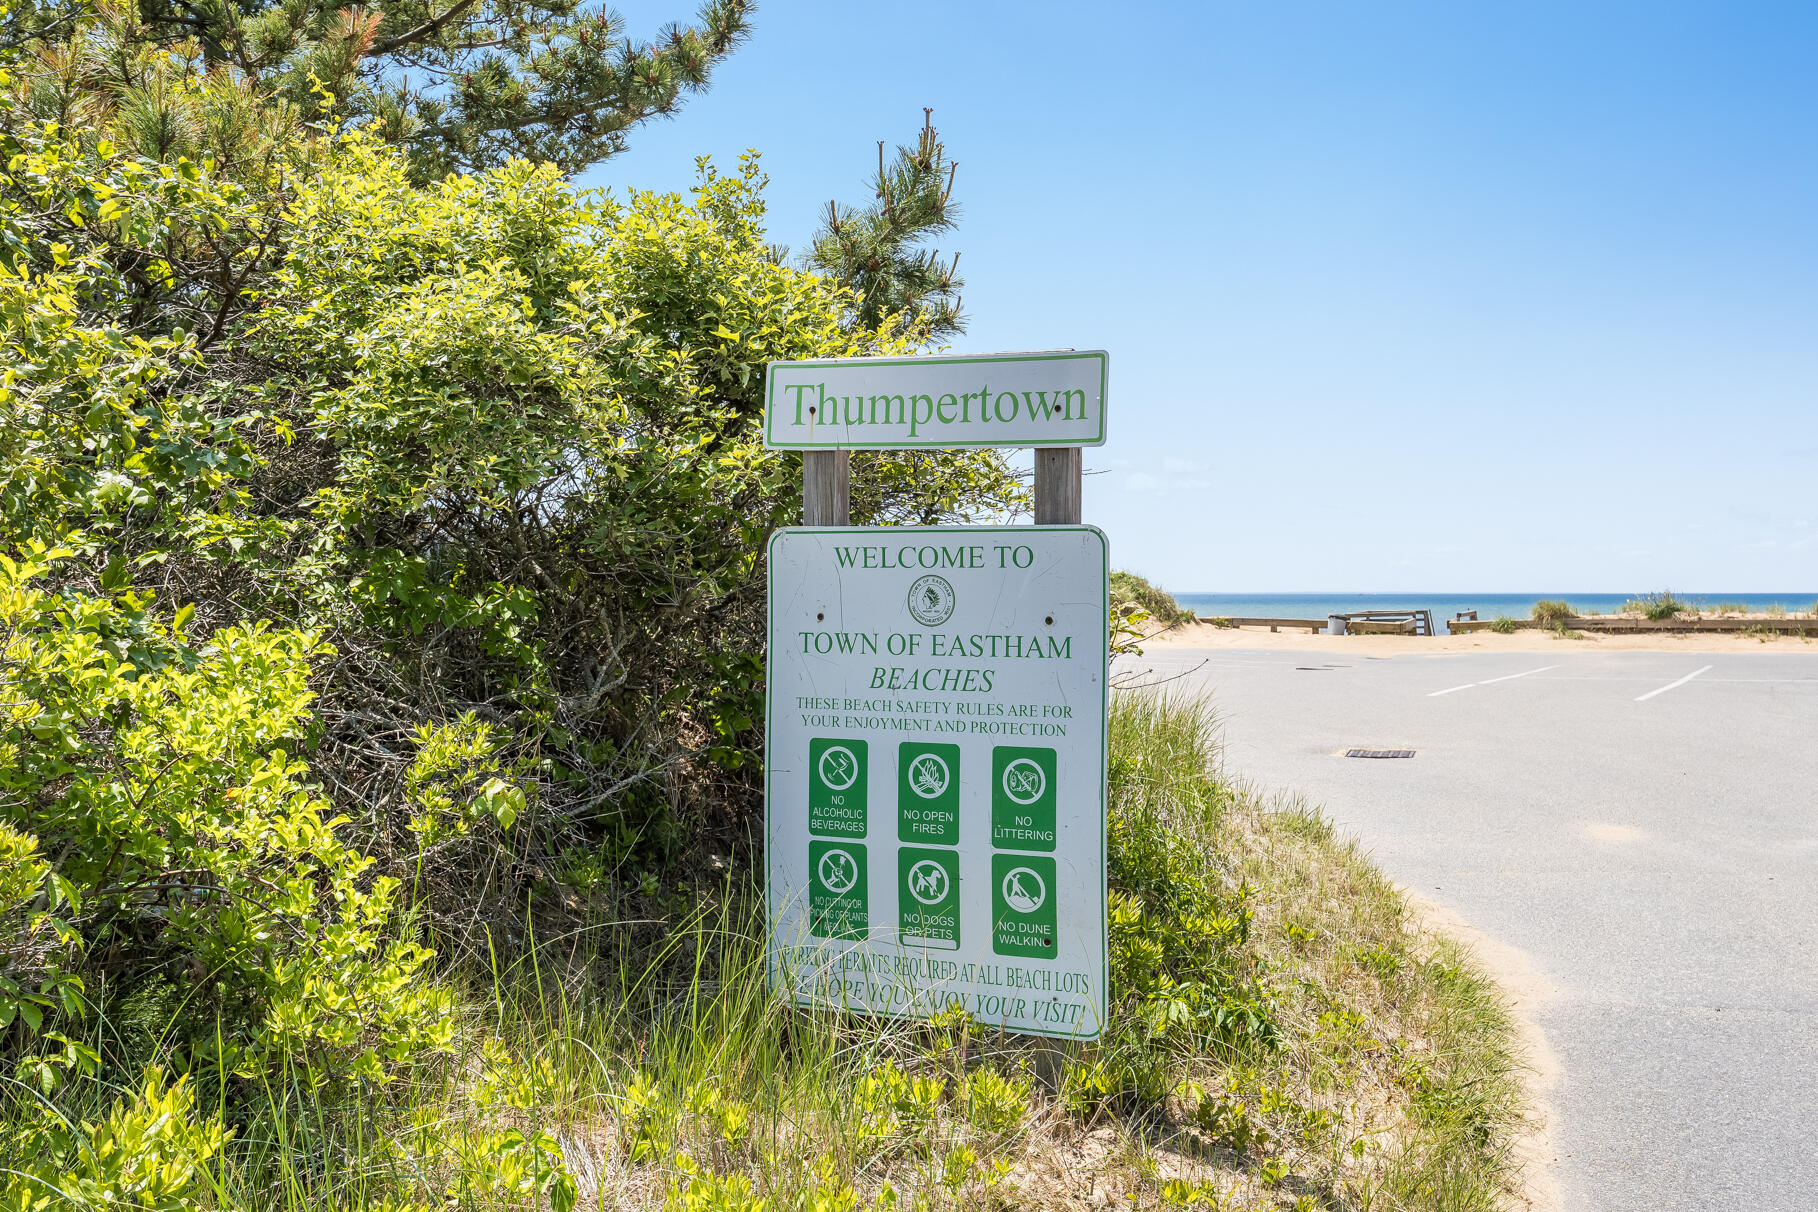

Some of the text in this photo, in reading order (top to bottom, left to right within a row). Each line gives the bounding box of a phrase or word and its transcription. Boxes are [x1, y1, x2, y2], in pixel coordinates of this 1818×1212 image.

[784, 382, 1089, 438] Thumpertown
[834, 545, 1034, 569] WELCOME TO
[798, 631, 1073, 660] TOWN OF EASTHAM
[868, 667, 995, 694] BEACHES
[795, 696, 1073, 719] THESE BEACH SAFETY RULES ARE FOR
[801, 714, 1067, 737] YOUR ENJOYMENT AND PROTECTION
[831, 795, 845, 806] NO
[812, 807, 863, 819] ALCOHOLIC
[903, 809, 953, 823] NO OPEN
[811, 819, 865, 832] BEVERAGES
[1015, 816, 1033, 827] NO
[912, 823, 944, 835] FIRES
[994, 826, 1054, 841] LITTERING
[814, 896, 862, 909] NO CUTTING OR
[835, 910, 844, 920] OF
[845, 911, 868, 923] PLANTS
[903, 913, 955, 927] NO DOGS
[905, 926, 953, 940] OR PETS
[999, 921, 1051, 935] NO DUNE
[999, 934, 1052, 948] WALKING
[838, 950, 890, 975] PERMITS
[894, 955, 959, 982] REQUIRED
[960, 962, 977, 983] AT
[977, 964, 1003, 986] ALL
[1006, 967, 1052, 991] BEACH
[1055, 971, 1090, 995] LOTS
[869, 981, 908, 1006] YOU
[911, 987, 971, 1012] ENJOY
[975, 994, 1026, 1019] YOUR
